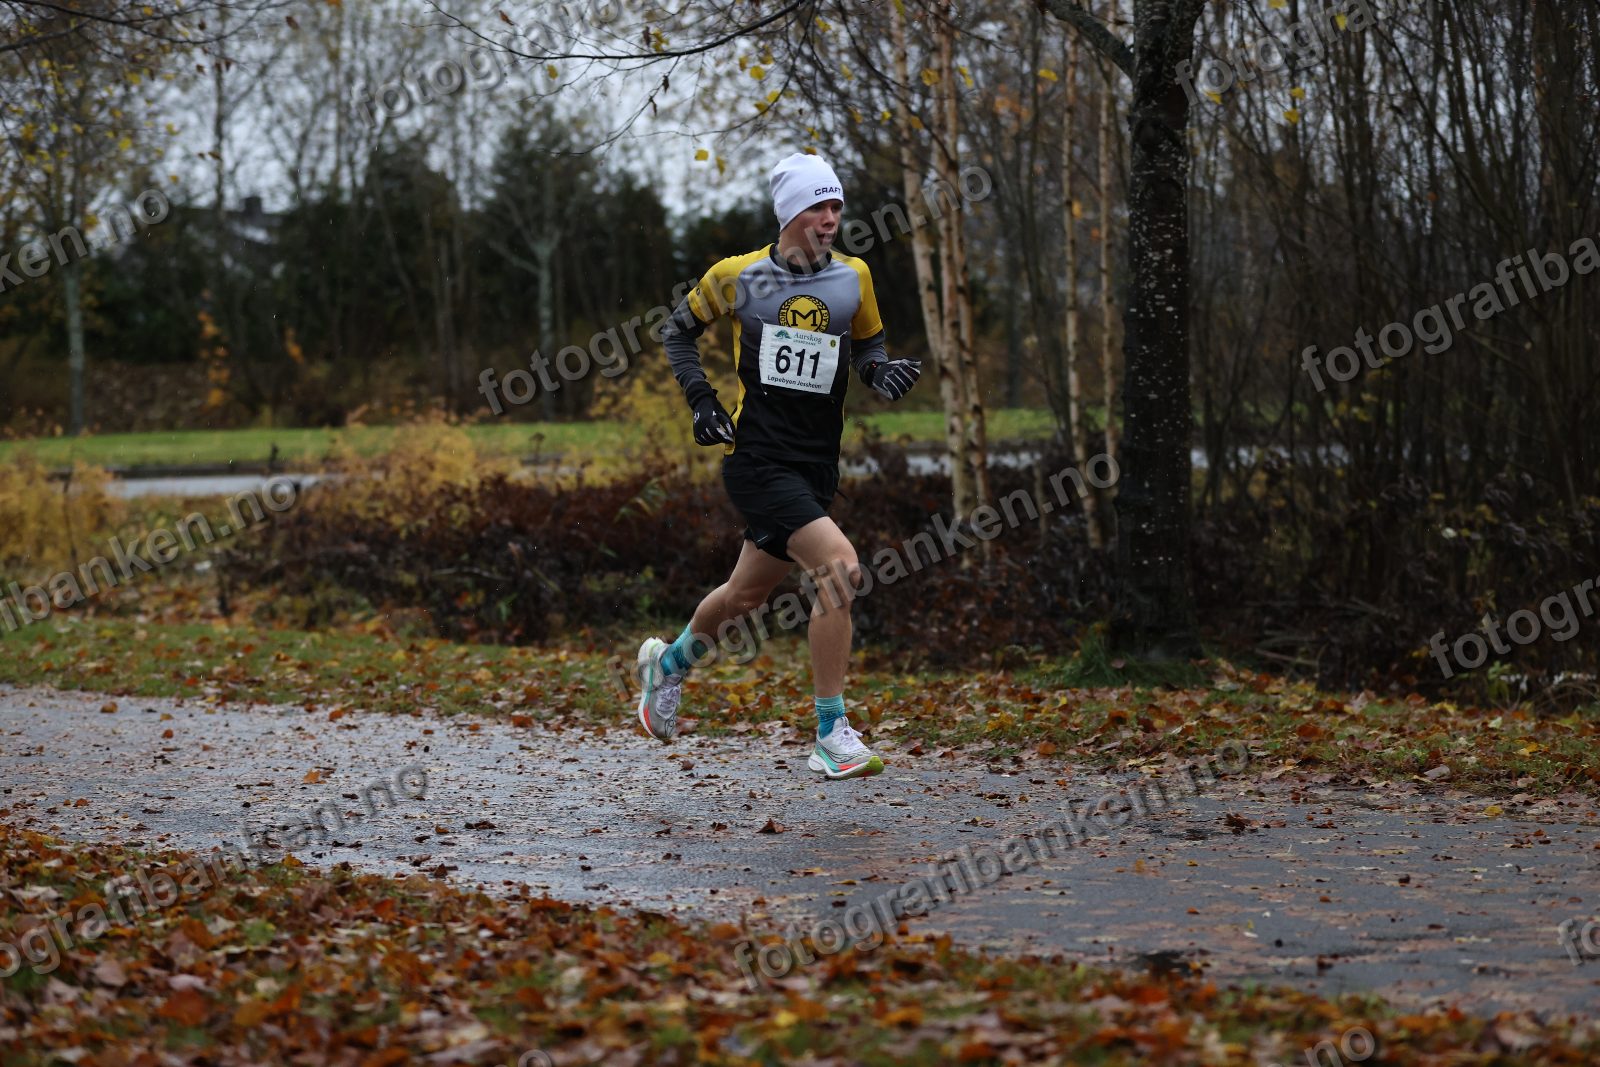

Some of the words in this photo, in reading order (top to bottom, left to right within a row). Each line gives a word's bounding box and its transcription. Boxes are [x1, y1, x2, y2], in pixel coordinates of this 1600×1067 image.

[814, 186, 841, 196] CRAFT
[790, 310, 818, 326] M
[775, 345, 820, 379] 611
